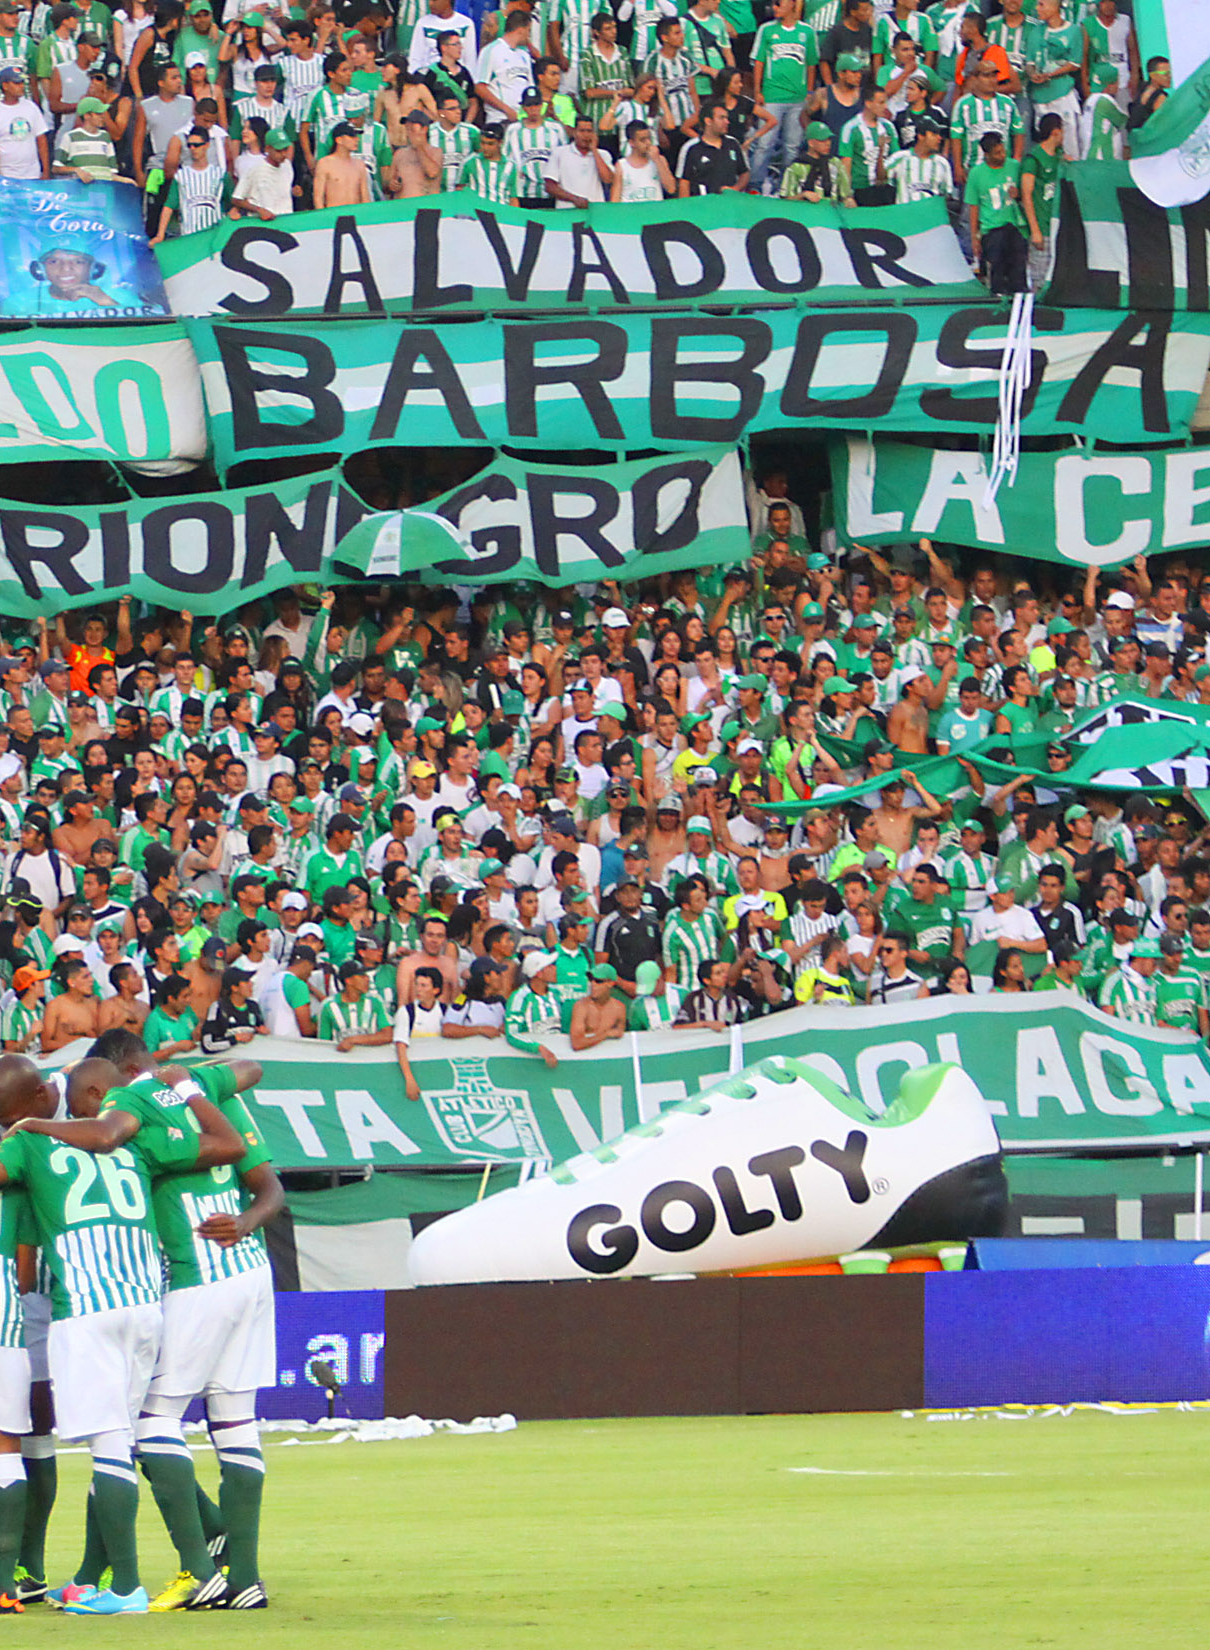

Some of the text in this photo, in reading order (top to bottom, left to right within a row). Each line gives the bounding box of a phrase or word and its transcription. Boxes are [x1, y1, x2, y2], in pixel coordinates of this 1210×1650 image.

[217, 209, 936, 314] SALVADOR
[213, 308, 1172, 449] BARBOSA
[846, 440, 1006, 544] LA
[552, 1025, 1210, 1152] VOLAGA
[50, 1146, 147, 1224] 26
[567, 1129, 870, 1274] GOLTY
